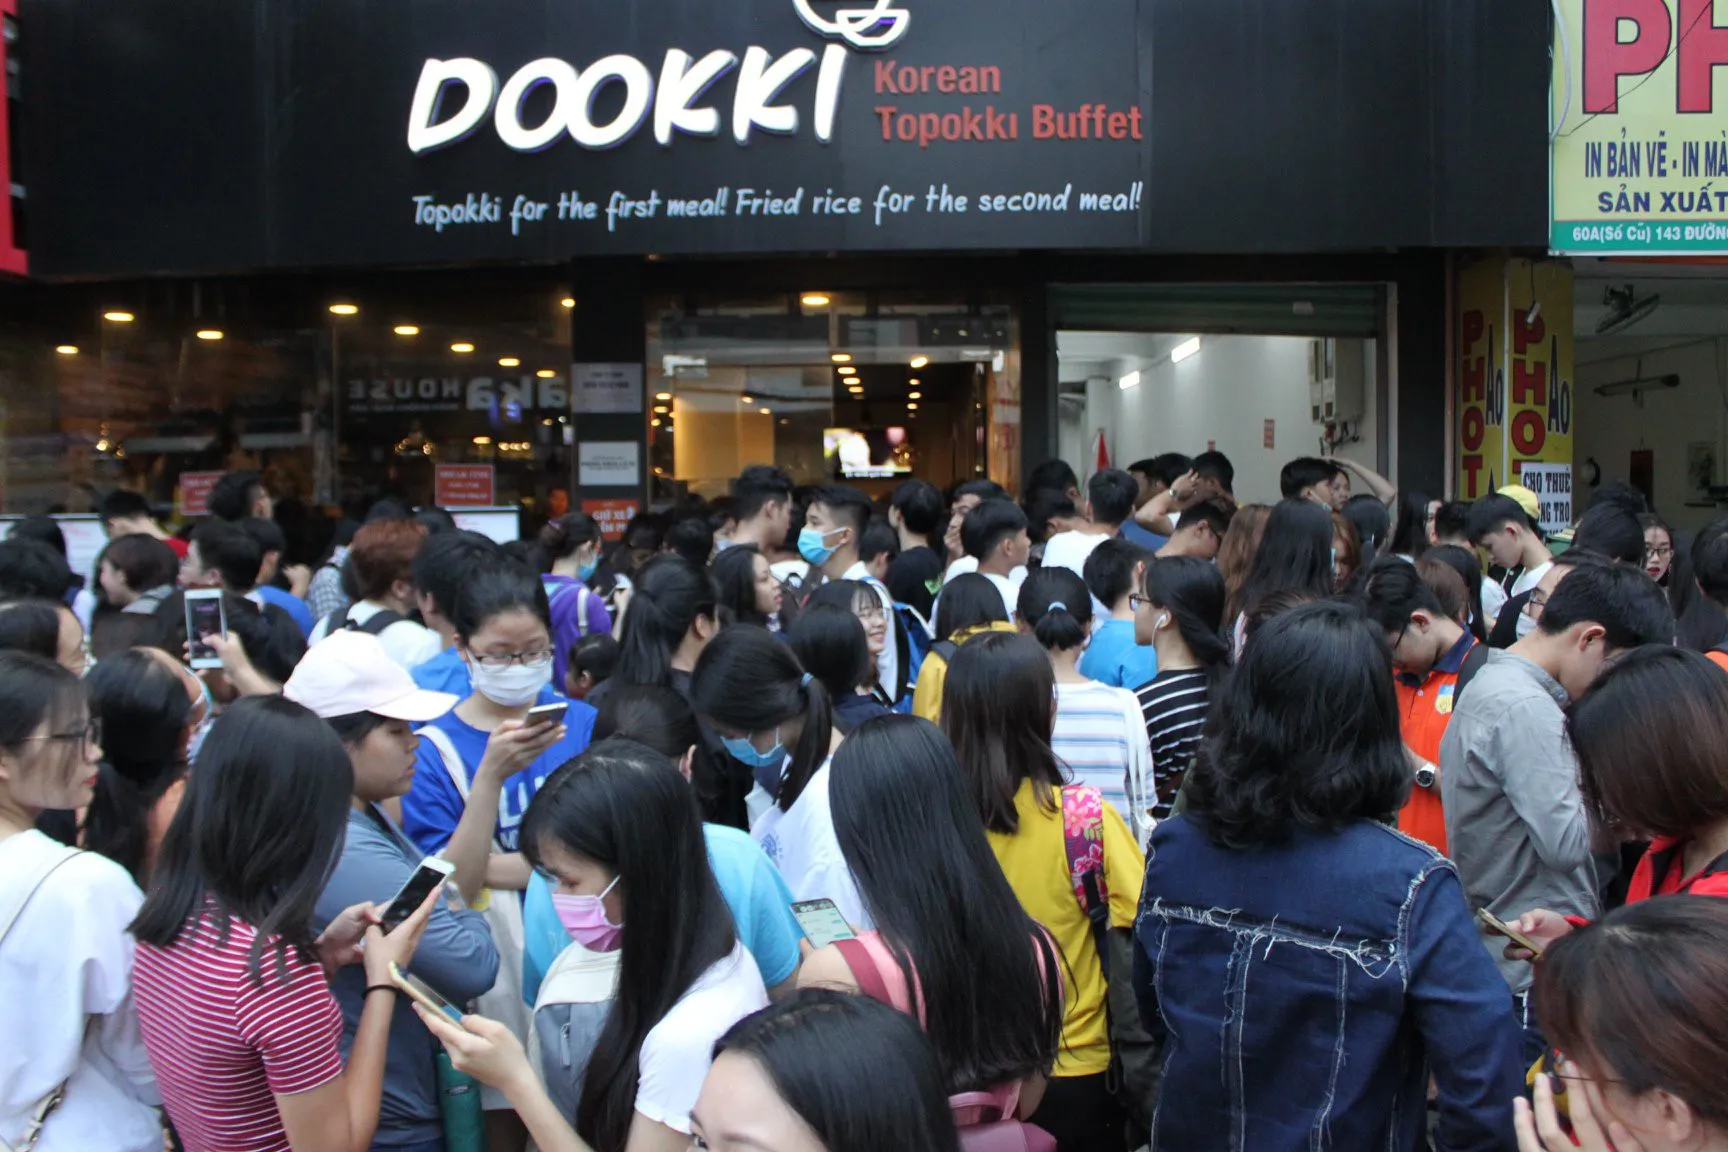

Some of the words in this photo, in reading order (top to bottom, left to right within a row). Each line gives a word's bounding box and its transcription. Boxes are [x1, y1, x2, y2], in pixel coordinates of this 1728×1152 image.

[874, 59, 1001, 94] Korean
[407, 43, 847, 156] DOOKKI
[1032, 103, 1143, 140] Buffet
[1585, 141, 1601, 178] IN
[1607, 127, 1641, 178] BẢN
[1646, 130, 1667, 178] VẼ
[1682, 141, 1699, 178] IN
[412, 192, 502, 233] Topokki
[509, 194, 549, 236] for
[557, 189, 598, 220] the
[605, 189, 662, 232] first
[667, 186, 729, 217] meal!
[735, 187, 804, 216] Fried
[812, 188, 862, 214] rice
[873, 185, 915, 226] for
[926, 183, 967, 212] the
[978, 183, 1072, 211] second
[1079, 181, 1143, 211] meal!
[1598, 183, 1650, 213] SẢN
[1660, 182, 1728, 213] XUẤT
[1655, 226, 1681, 241] 143
